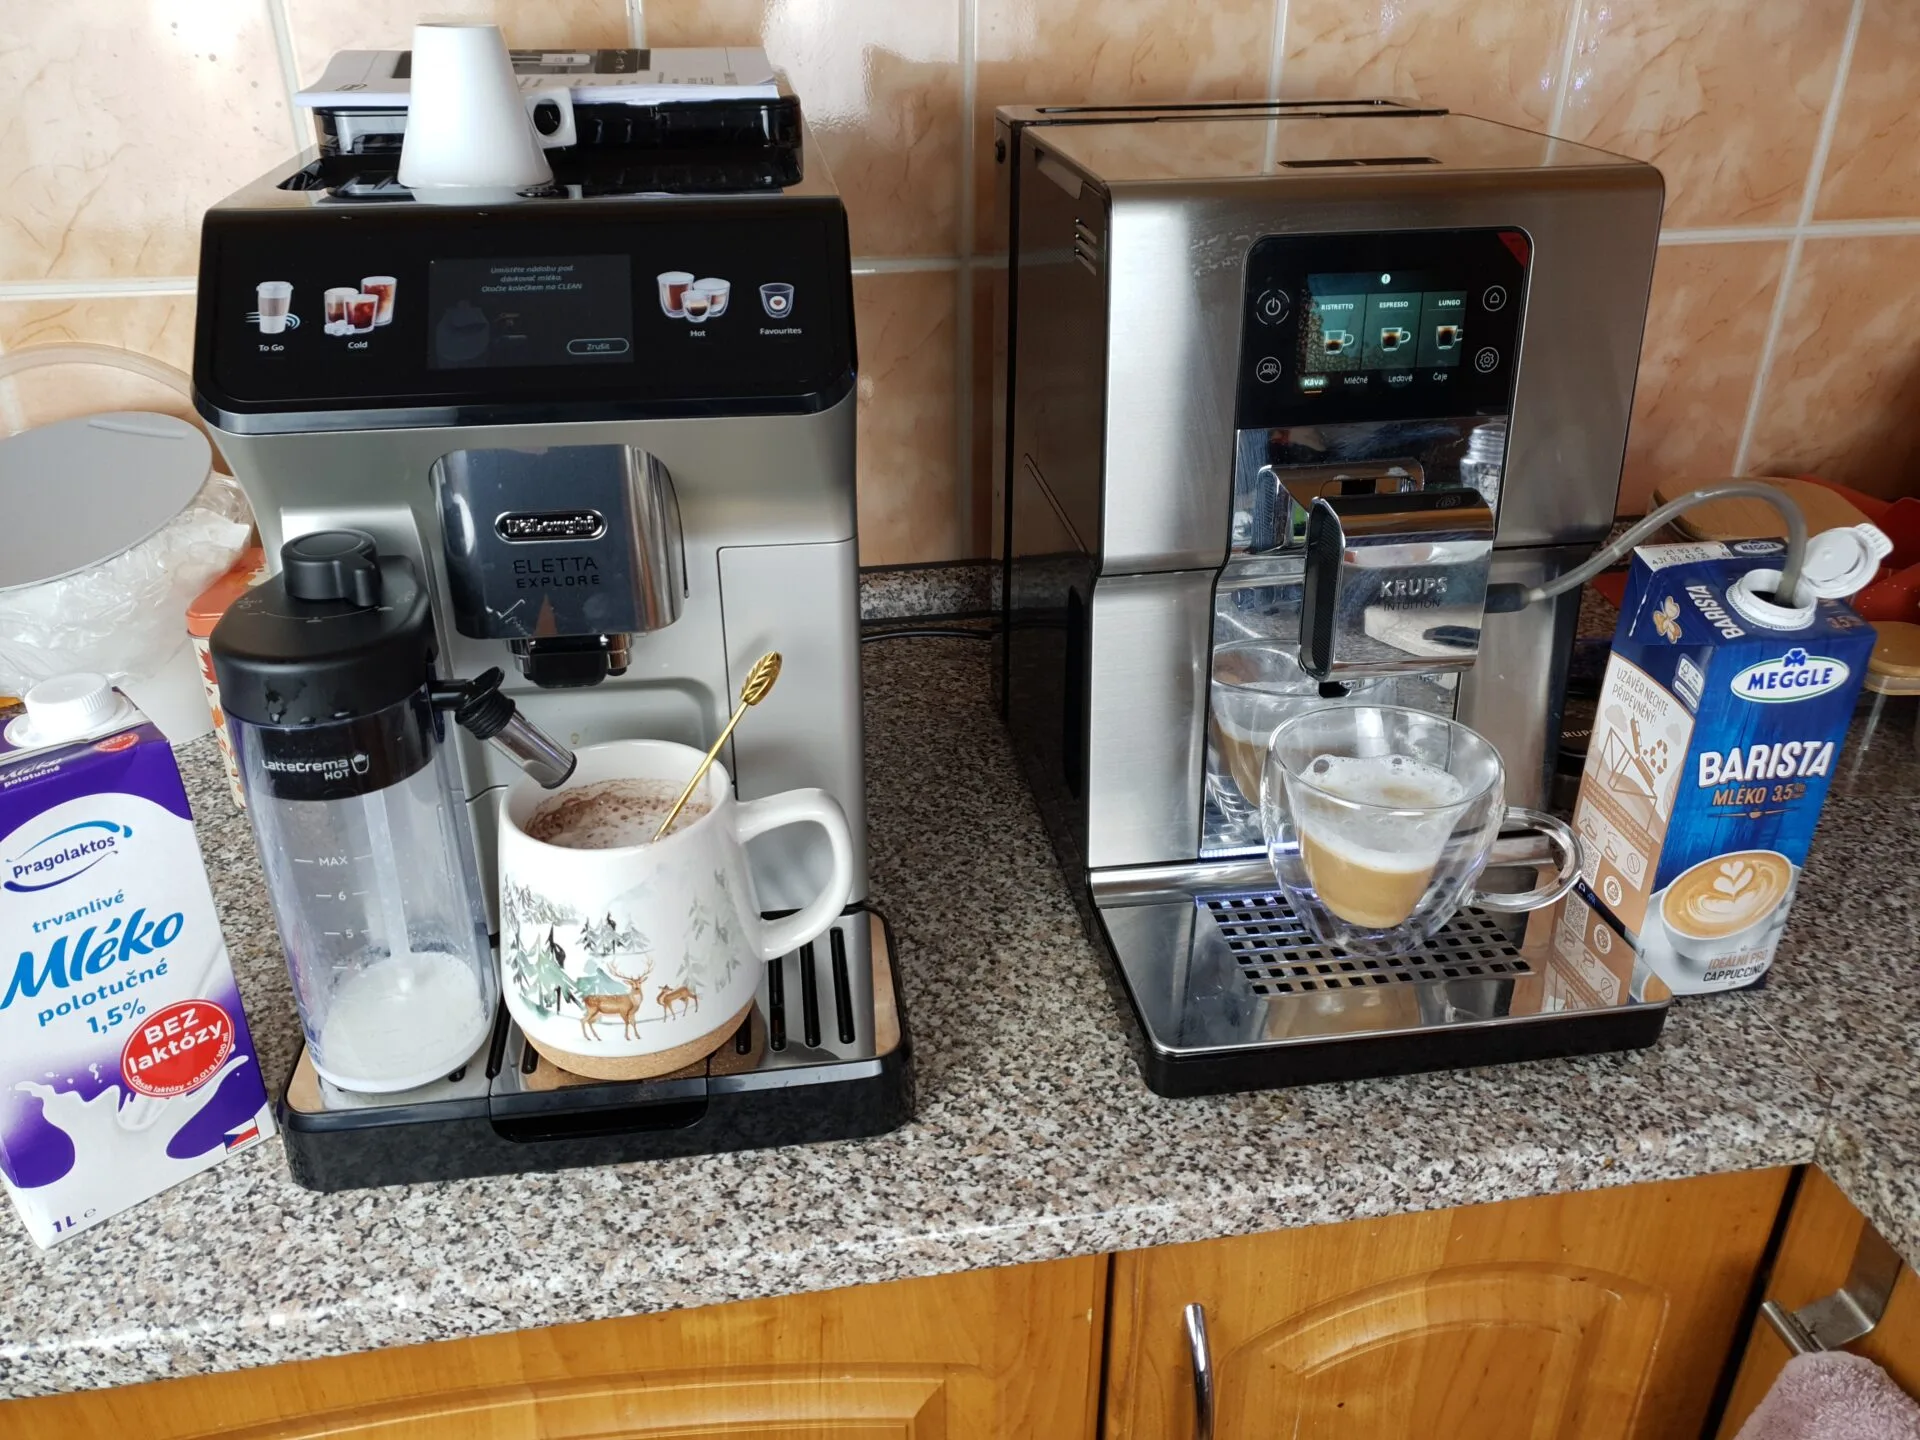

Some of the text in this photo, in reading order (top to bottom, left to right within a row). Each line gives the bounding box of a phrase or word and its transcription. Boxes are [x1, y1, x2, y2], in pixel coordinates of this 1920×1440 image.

[557, 282, 582, 290] CLEAN
[1321, 303, 1354, 311] RISTRETTO
[1379, 301, 1409, 309] ESPRESSO
[690, 329, 706, 337] Hot
[347, 341, 368, 349] Cold
[1304, 371, 1448, 386] Káva Mléčné Ledové Čaje
[513, 557, 599, 574] ELETTA
[516, 574, 601, 589] EXPLORE
[1379, 576, 1448, 598] KRUPS
[1384, 600, 1440, 611] INTUITION
[1685, 585, 1746, 640] BARISTA
[1747, 667, 1834, 691] MEGGLE
[1644, 687, 1669, 717] NECHTE
[261, 758, 349, 773] LatteCrema
[1698, 741, 1836, 789] BARISTA
[4, 765, 61, 789] polotučné
[323, 768, 350, 780] HOT
[1712, 785, 1768, 806] MLÉKO
[12, 836, 116, 879] Pragolaktos
[318, 855, 348, 867] MAX
[338, 891, 347, 901] 6
[32, 889, 125, 934] trvanlivé
[345, 928, 354, 939] 5
[0, 907, 184, 1010] Mléko
[1703, 962, 1765, 982] CAPPUCCINO
[37, 957, 169, 1028] polotučné
[86, 997, 147, 1035] 1,5%
[143, 1007, 200, 1046] BEZ
[221, 1031, 230, 1043] ml
[128, 1020, 223, 1074] laktózy
[216, 1042, 227, 1058] 100
[131, 1074, 153, 1092] Obsah
[153, 1084, 185, 1094] laktózy
